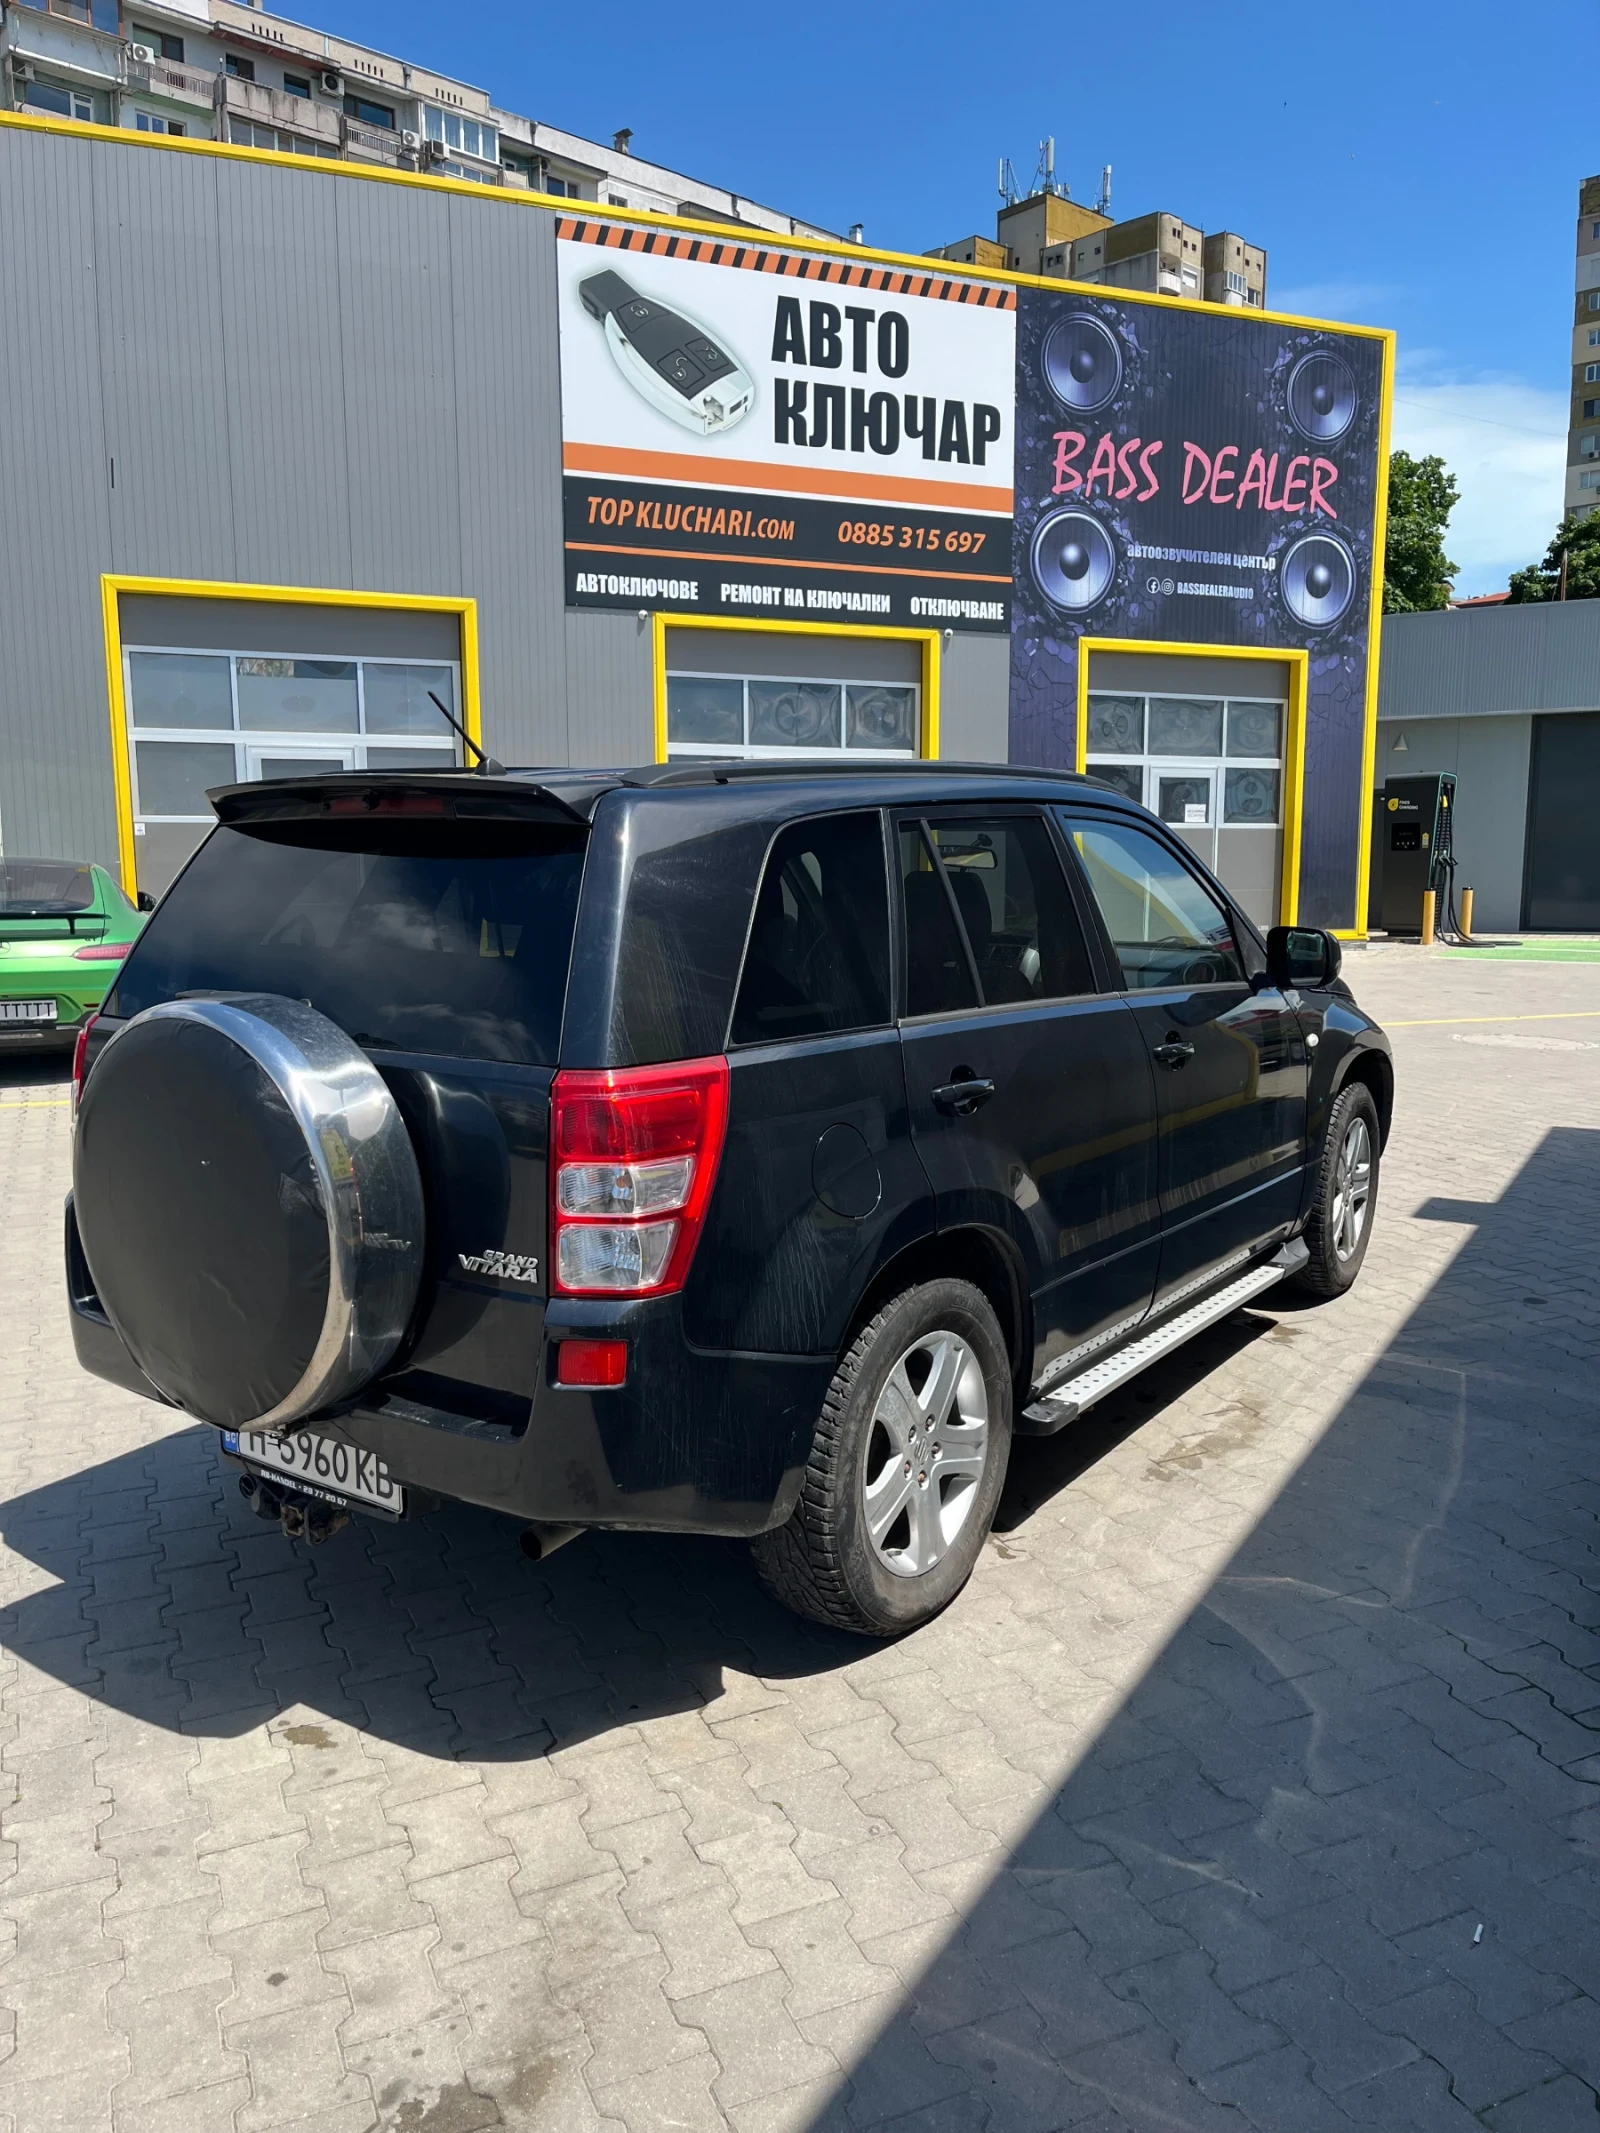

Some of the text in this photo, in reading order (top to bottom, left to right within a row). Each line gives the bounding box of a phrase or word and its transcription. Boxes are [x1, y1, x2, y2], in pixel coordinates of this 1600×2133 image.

[771, 295, 909, 379] АВТО
[774, 378, 1001, 466] КЛЮЧАР
[1051, 431, 1338, 519] BASS DEALER
[838, 521, 986, 554] 0885 315 697
[1127, 544, 1276, 571] автоозвучителен център
[576, 572, 699, 600] АВТОКЛЮЧОВЕ
[721, 583, 891, 613] РЕМОНТ НА КЛЮЧАЛКИ
[1177, 582, 1254, 600] BASSDEALERAUDIO
[910, 596, 1004, 620] ОТКЛЮЧВАНЕ
[458, 1253, 538, 1284] VITARA
[482, 1249, 539, 1269] GRAND
